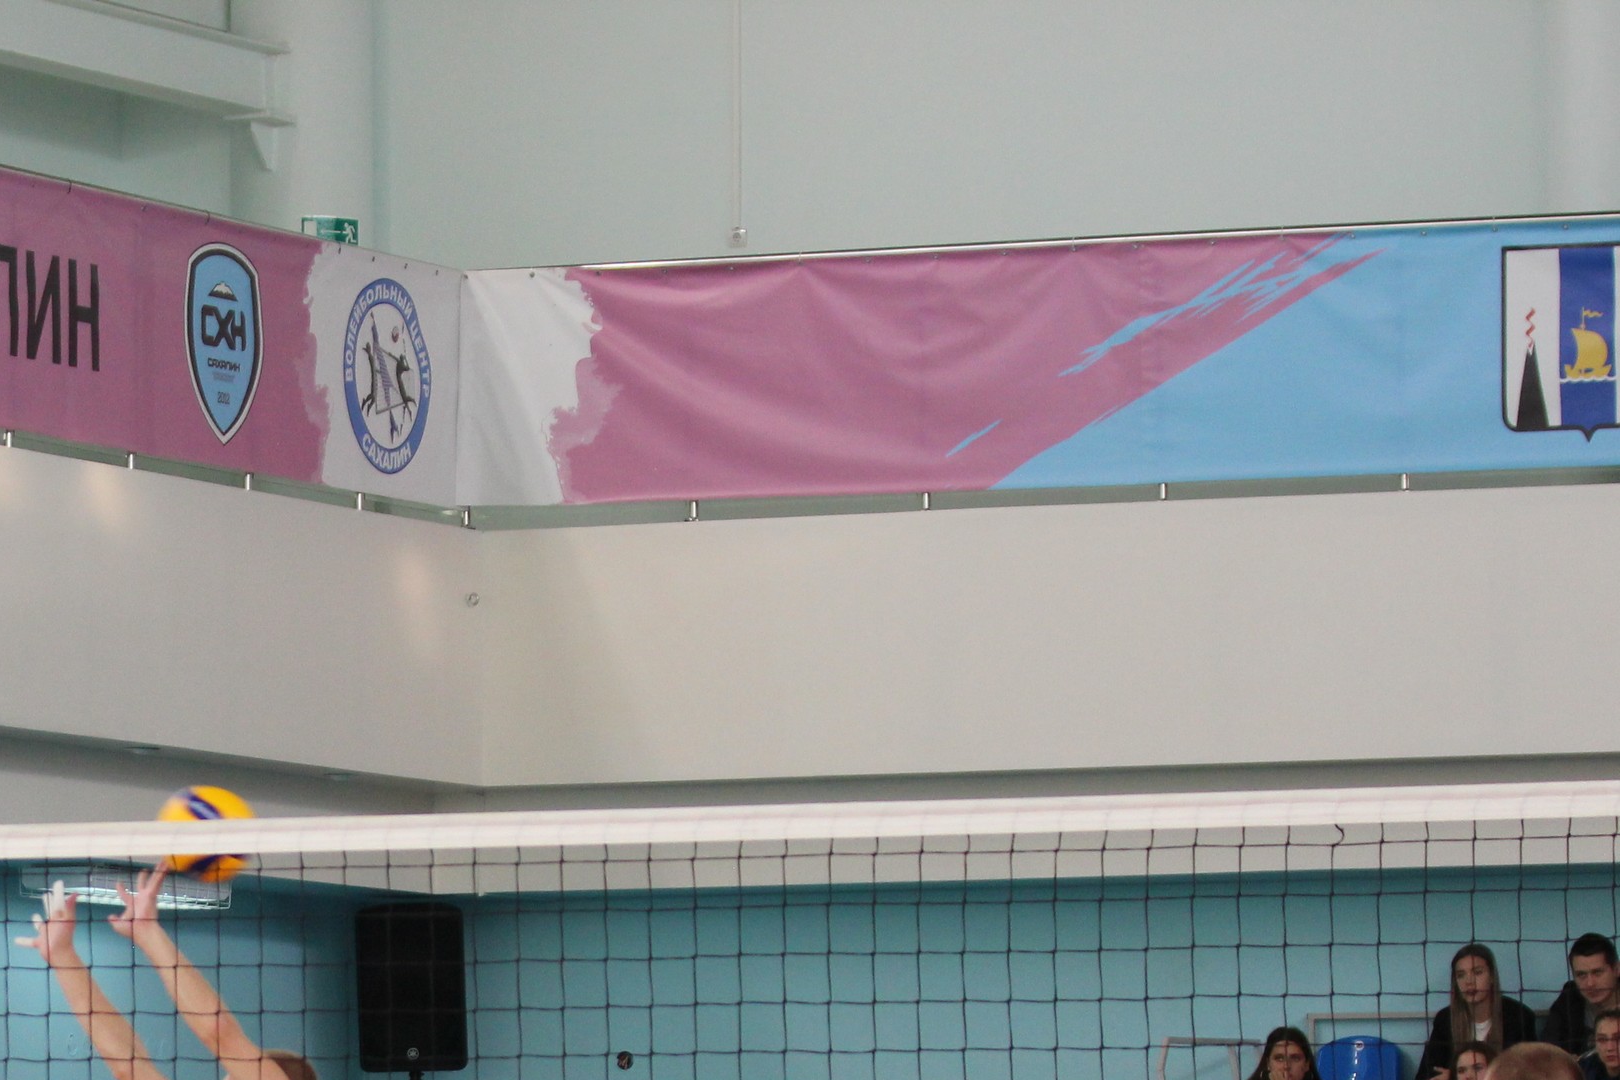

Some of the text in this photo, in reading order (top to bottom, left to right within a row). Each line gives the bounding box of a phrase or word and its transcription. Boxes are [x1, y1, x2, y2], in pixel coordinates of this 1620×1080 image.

[345, 284, 430, 399] ВОЛЕЙБОЛЬНЫЙ ЦЕНТР
[362, 432, 413, 470] САХАЛИН
